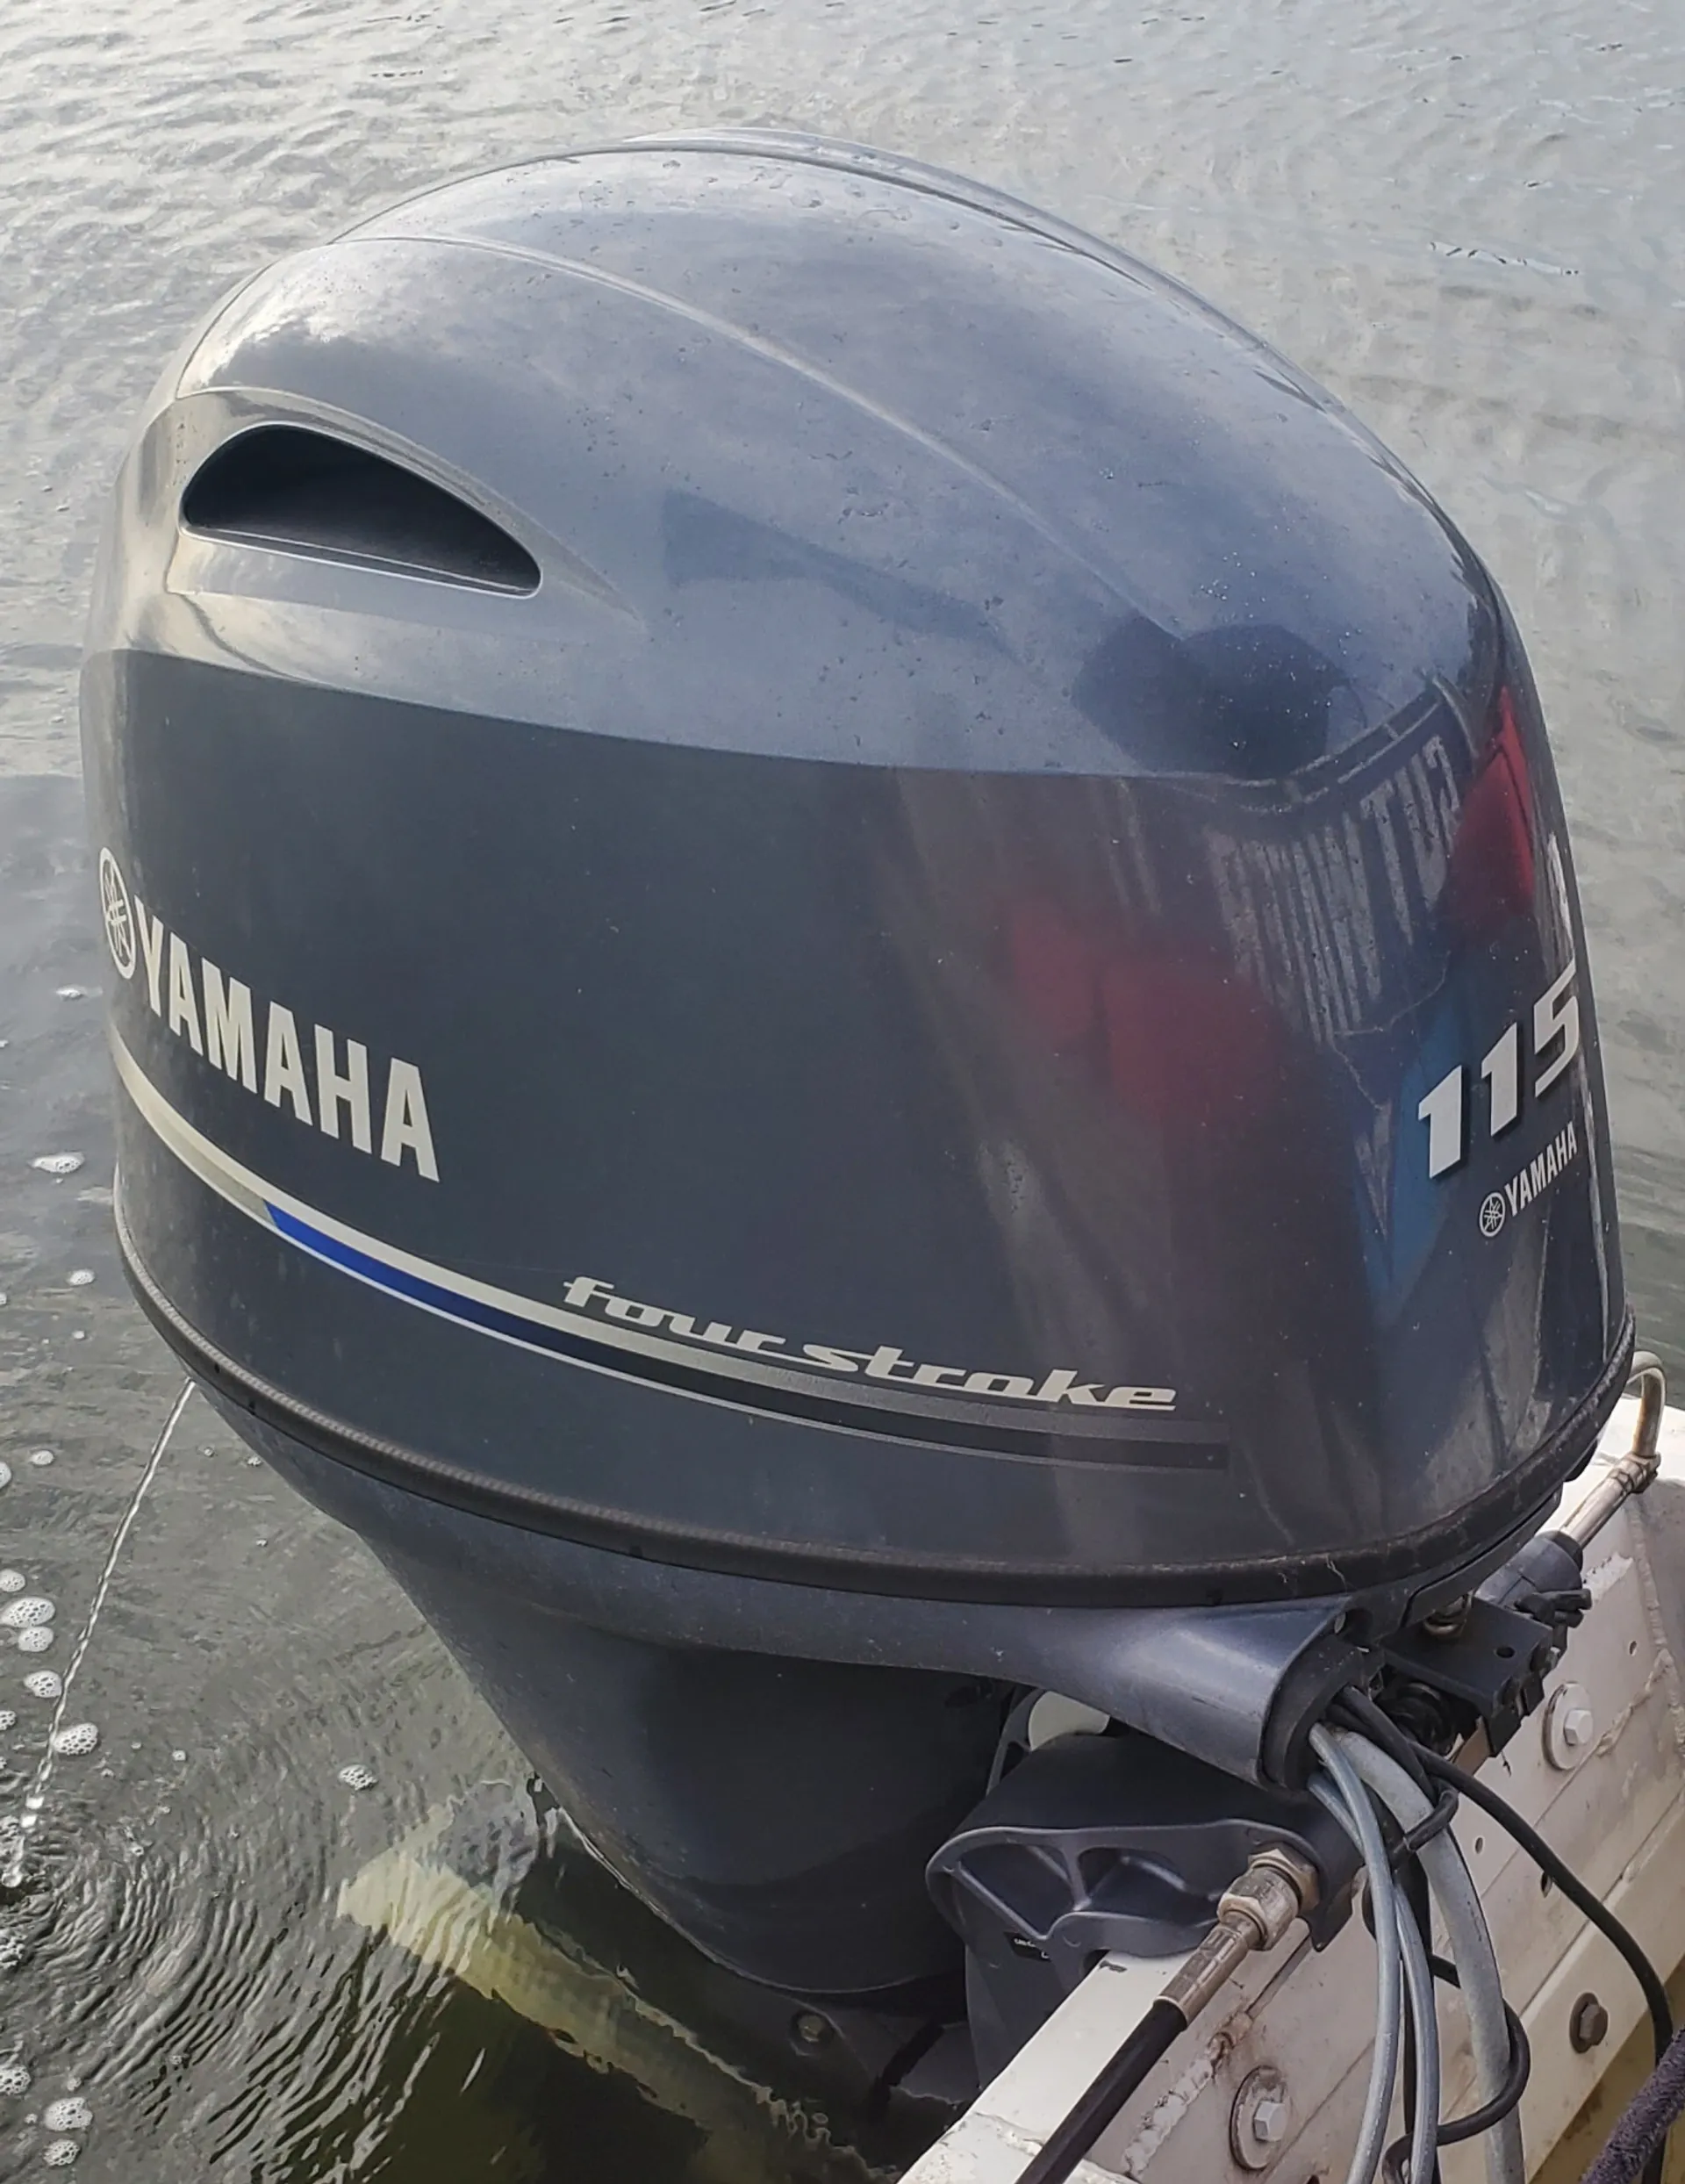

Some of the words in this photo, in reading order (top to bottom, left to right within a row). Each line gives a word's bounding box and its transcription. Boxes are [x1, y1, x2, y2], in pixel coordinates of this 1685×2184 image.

[134, 894, 440, 1182] YAMAHA
[1418, 957, 1580, 1179] 115
[1503, 1120, 1578, 1218] YAMAHA
